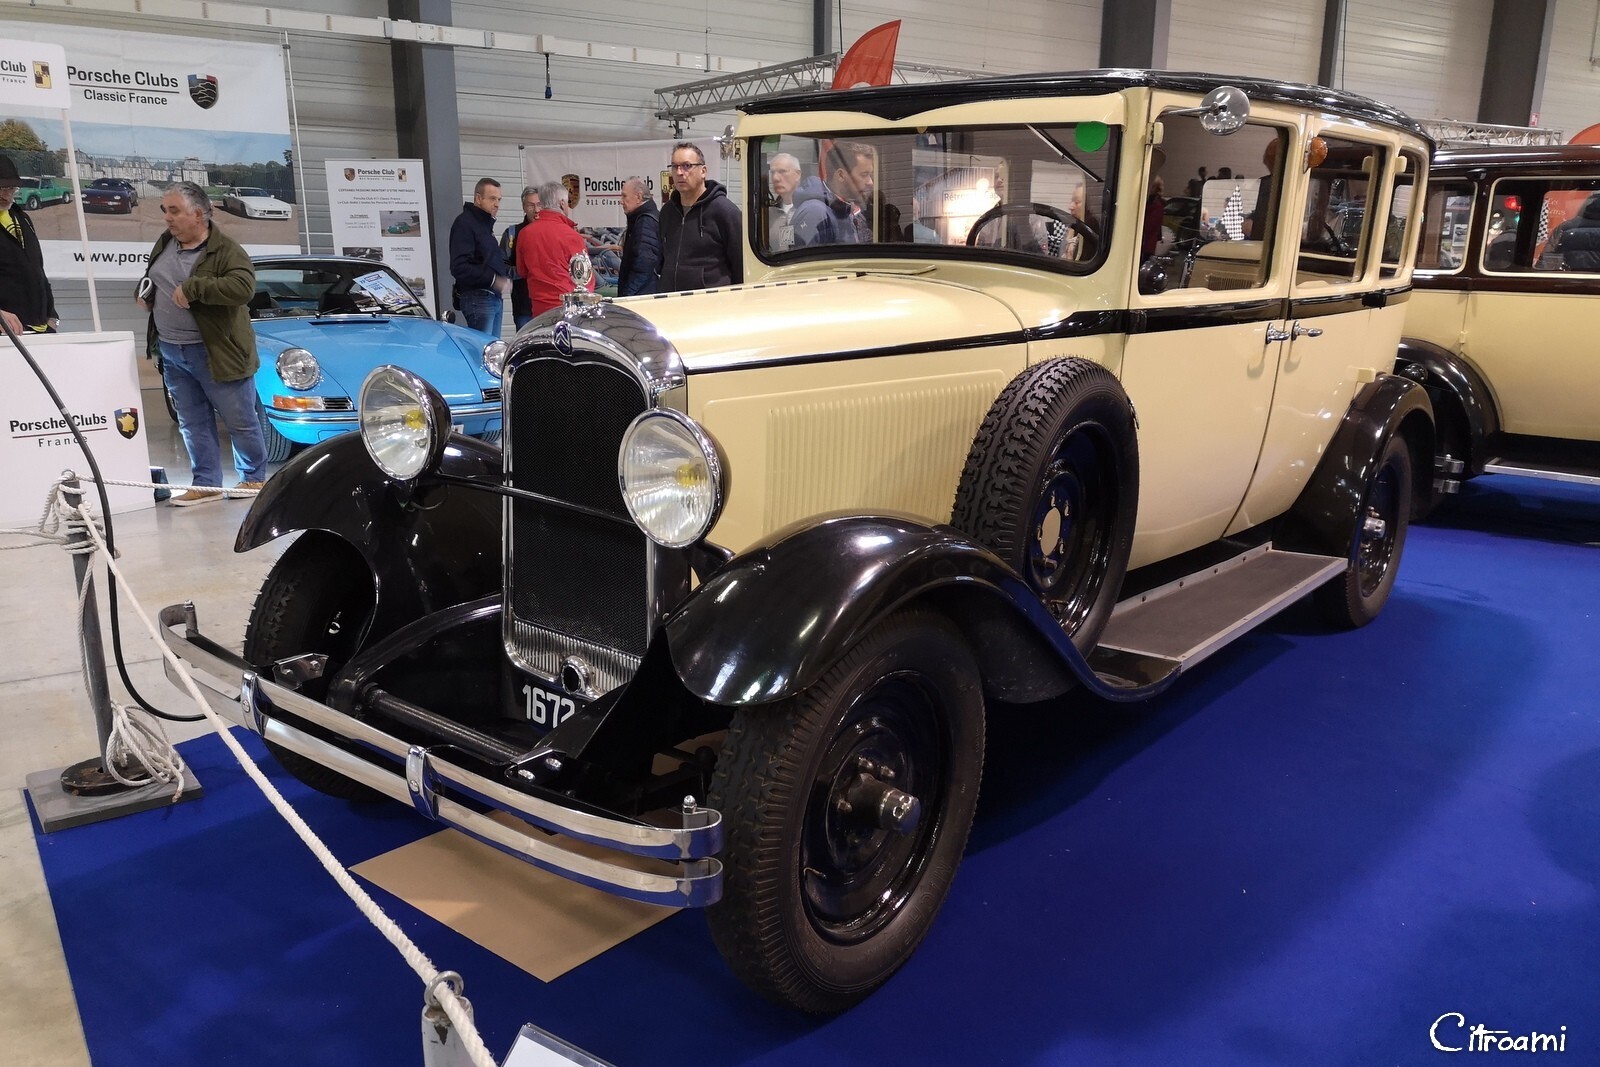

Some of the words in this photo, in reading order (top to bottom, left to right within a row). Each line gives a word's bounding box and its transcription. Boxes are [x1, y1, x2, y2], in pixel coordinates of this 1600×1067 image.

[1, 60, 26, 73] Club
[67, 66, 131, 84] Porsche
[134, 70, 179, 88] Clubs
[84, 89, 127, 103] Classic
[129, 92, 168, 105] France
[9, 418, 66, 432] Porsche
[72, 413, 107, 427] Clubs
[522, 684, 576, 729] 1672
